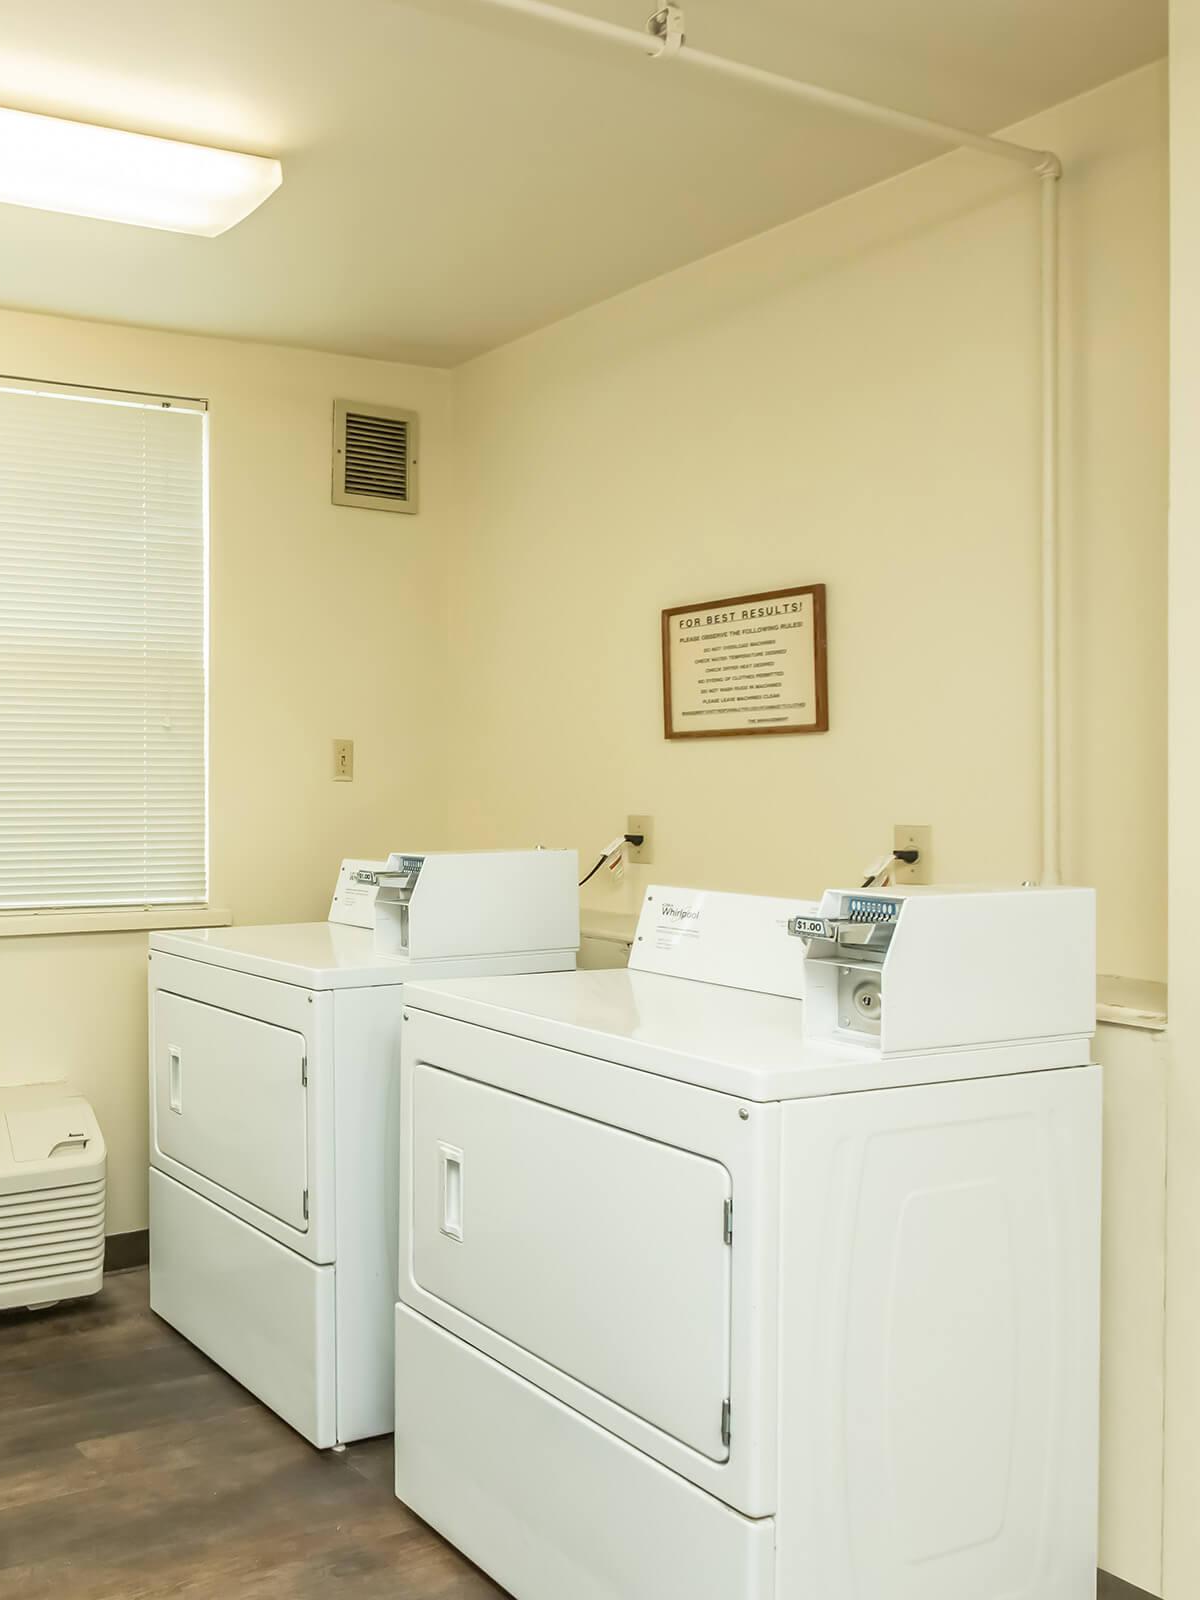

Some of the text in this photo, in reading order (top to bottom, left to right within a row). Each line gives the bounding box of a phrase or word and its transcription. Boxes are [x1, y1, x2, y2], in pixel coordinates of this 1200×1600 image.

[679, 602, 803, 629] FOR BEST RESULTS!
[701, 632, 728, 641] OBSERVE
[742, 624, 779, 635] FOLLOWING
[661, 907, 700, 920] Whirlpool
[796, 921, 822, 932] $1.00
